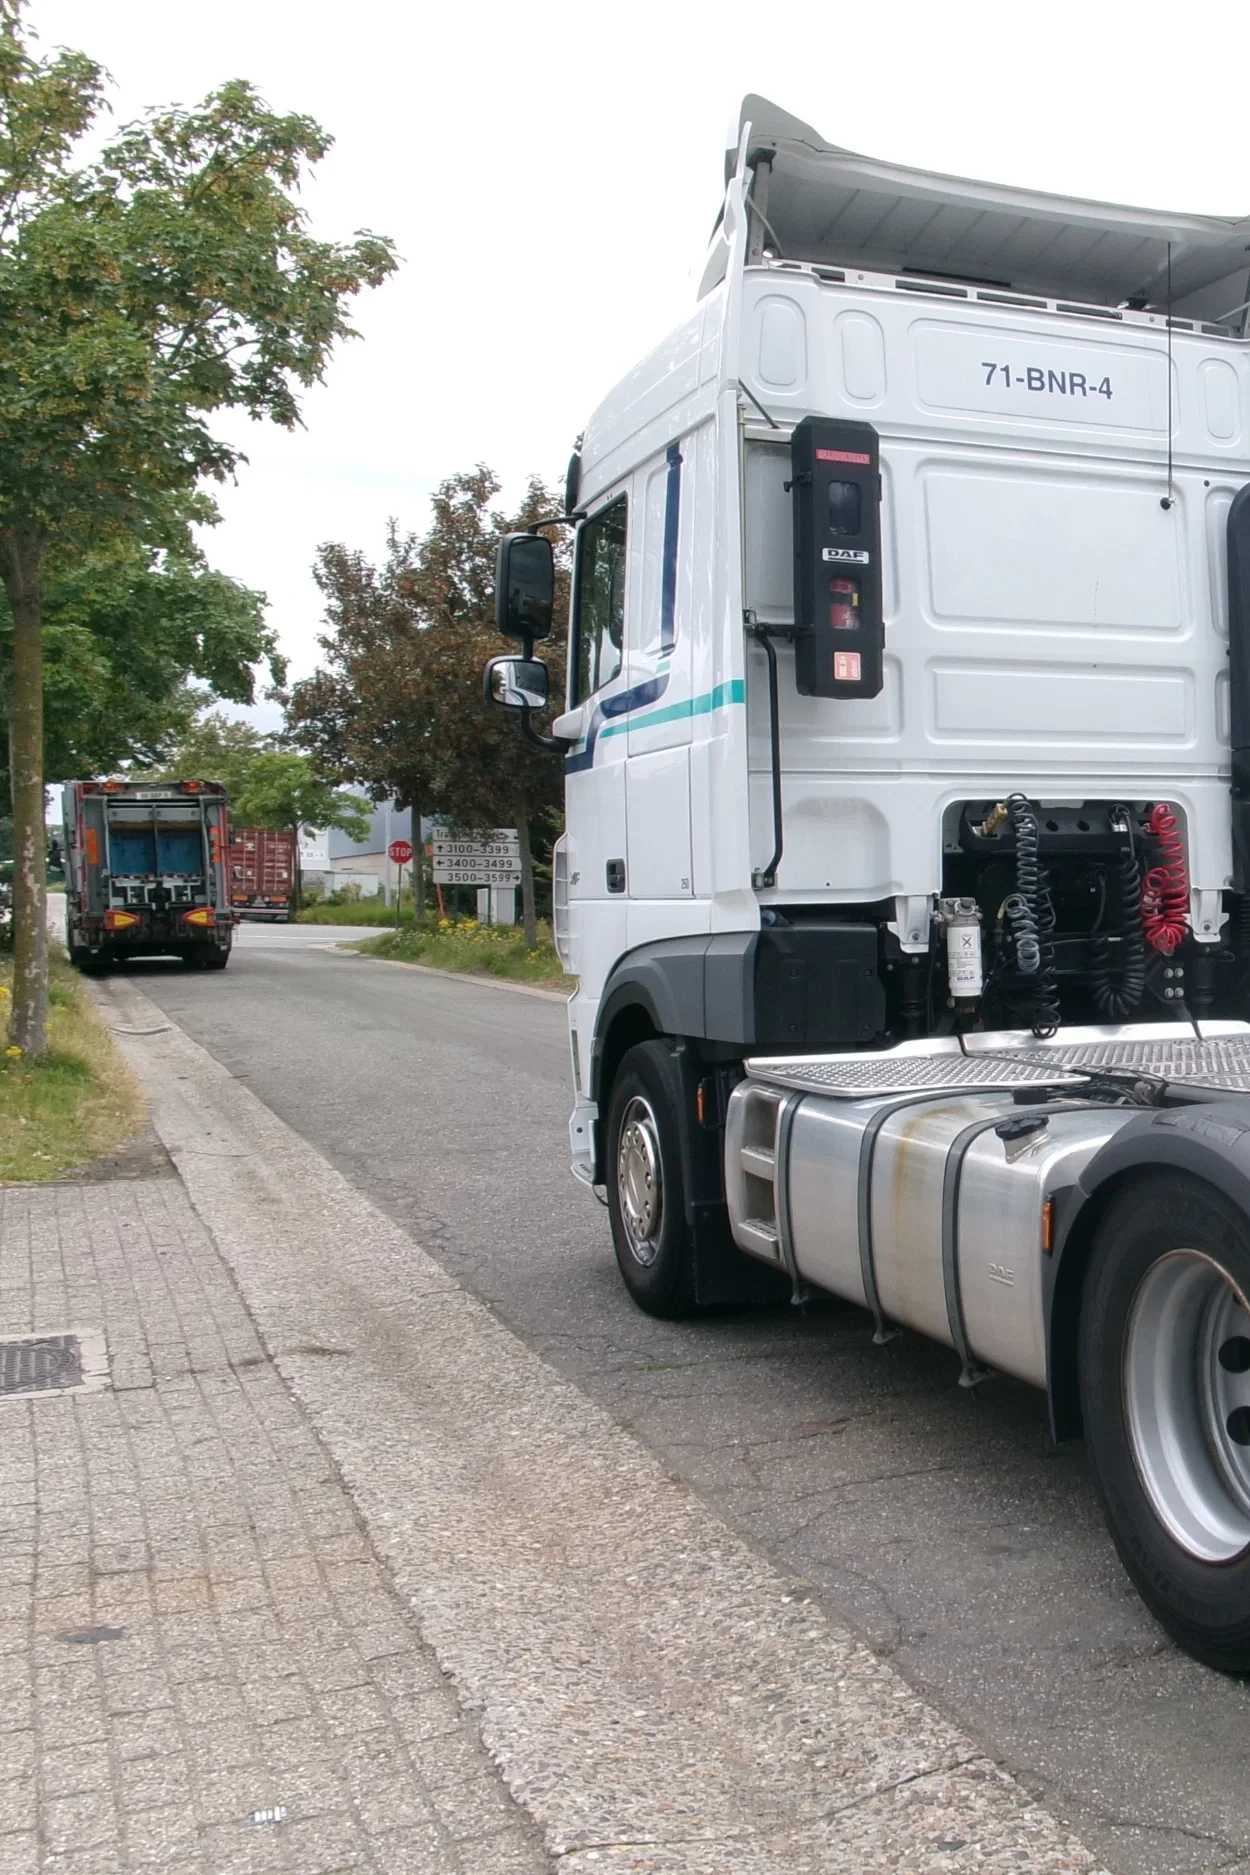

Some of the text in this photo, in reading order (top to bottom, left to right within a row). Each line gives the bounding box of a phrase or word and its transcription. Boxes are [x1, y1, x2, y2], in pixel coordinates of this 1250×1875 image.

[981, 362, 1113, 400] 71-BNR-4
[828, 550, 864, 558] DAF
[389, 847, 413, 857] STOP
[446, 844, 509, 854] 3100-3399
[446, 858, 513, 869] 3400-3499
[447, 872, 511, 882] 3500-3599
